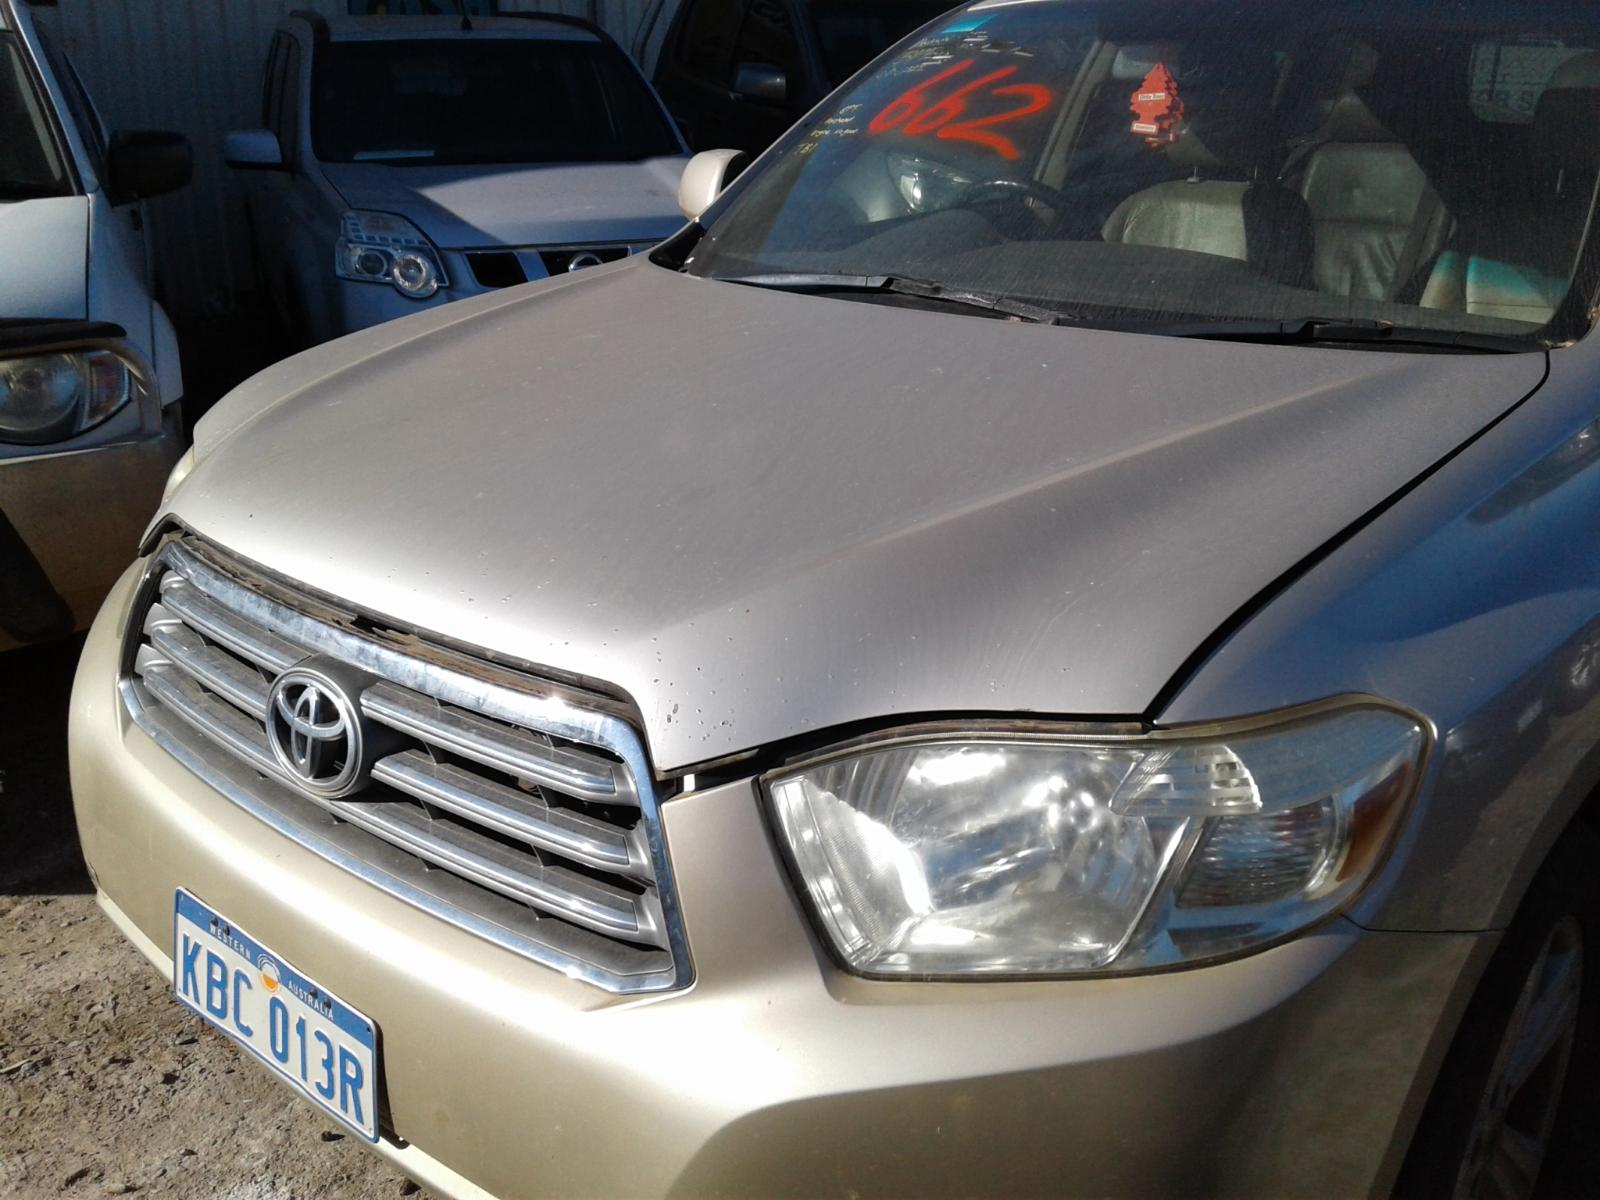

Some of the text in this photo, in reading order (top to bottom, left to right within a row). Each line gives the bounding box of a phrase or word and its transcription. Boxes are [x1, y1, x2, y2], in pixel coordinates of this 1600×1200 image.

[868, 58, 1054, 161] 662
[209, 924, 334, 1022] WESTERN AUSTRALIA
[182, 933, 365, 1126] KBC 013R
